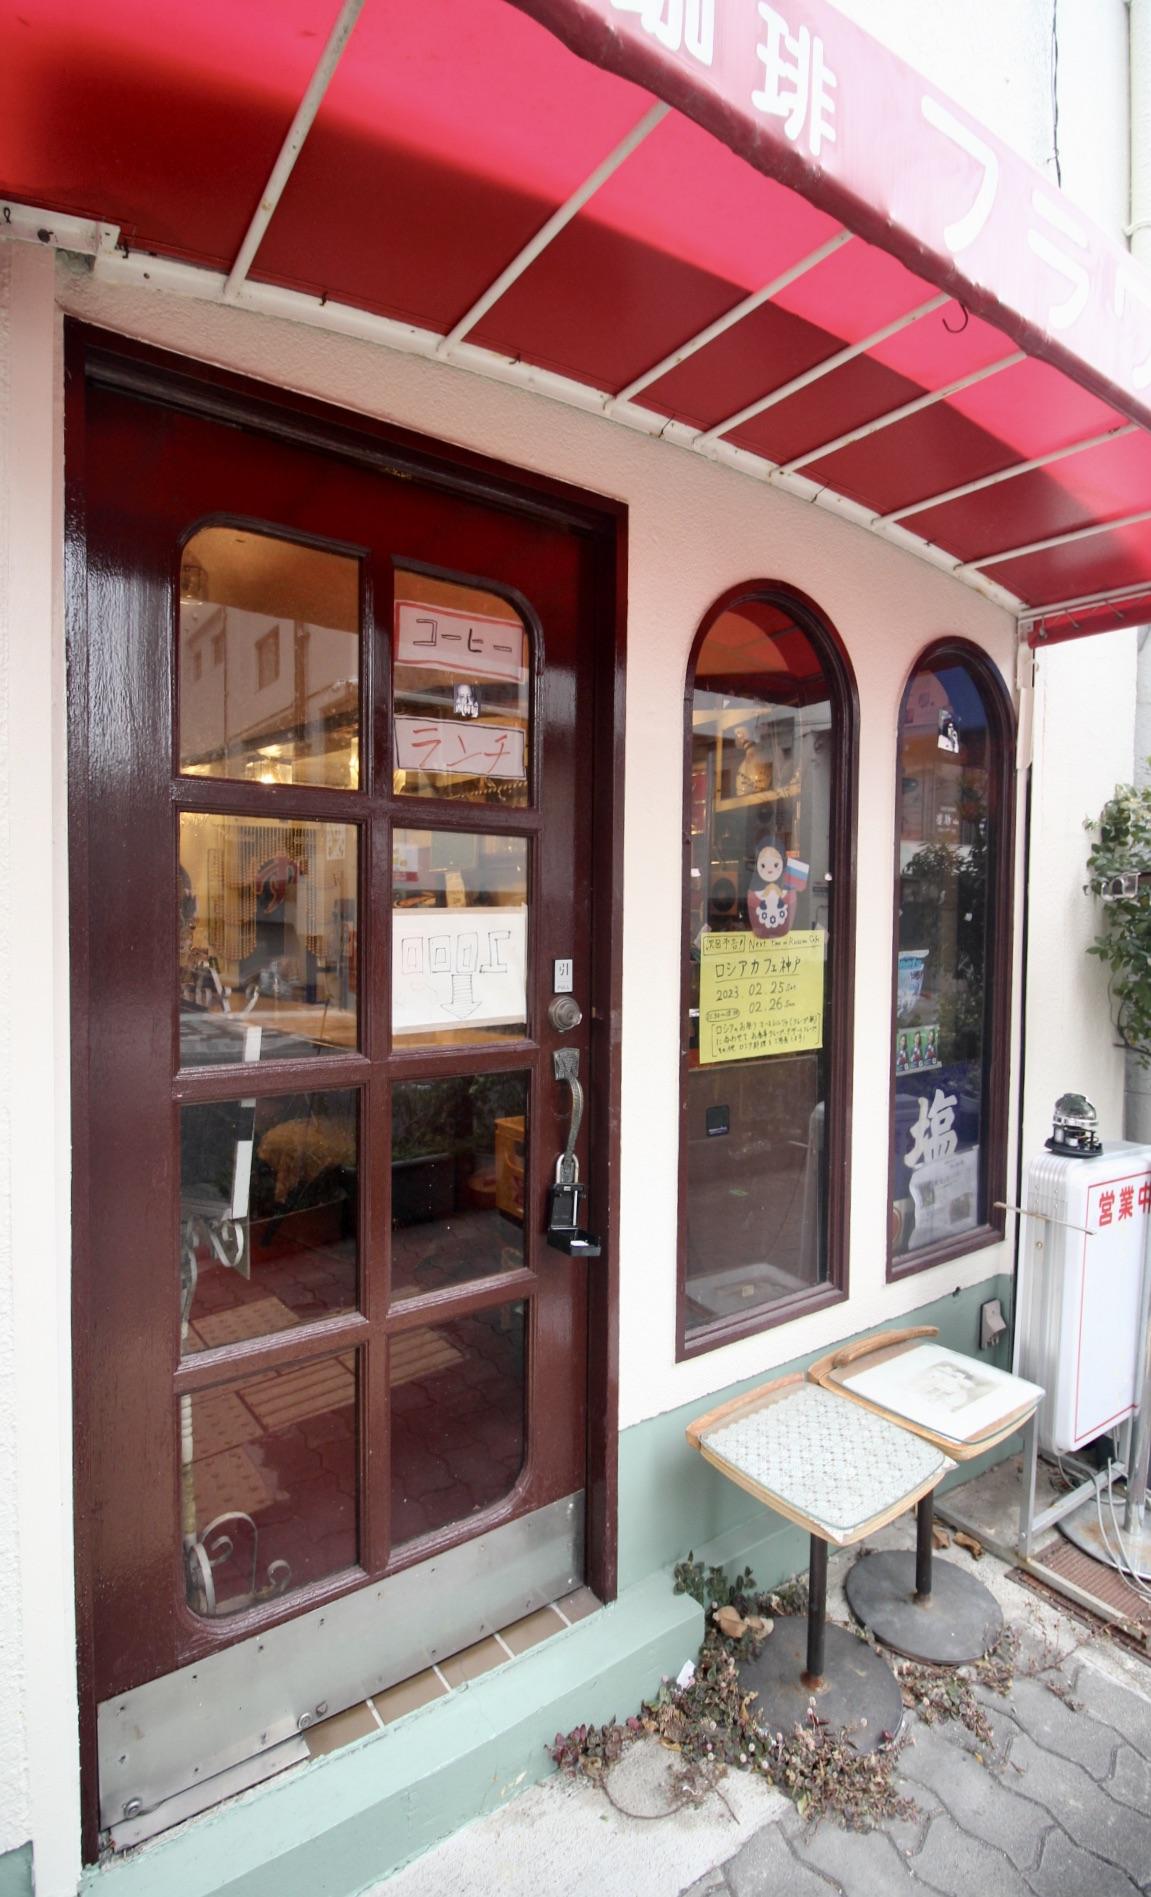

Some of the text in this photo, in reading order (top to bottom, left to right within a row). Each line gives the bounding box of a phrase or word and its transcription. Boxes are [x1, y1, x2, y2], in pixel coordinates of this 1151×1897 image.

[413, 618, 512, 653] コーヒー
[411, 728, 511, 773] ランチ
[748, 938, 766, 951] Next
[558, 962, 569, 977] 引
[716, 956, 801, 978] ロシアカフェ神戸
